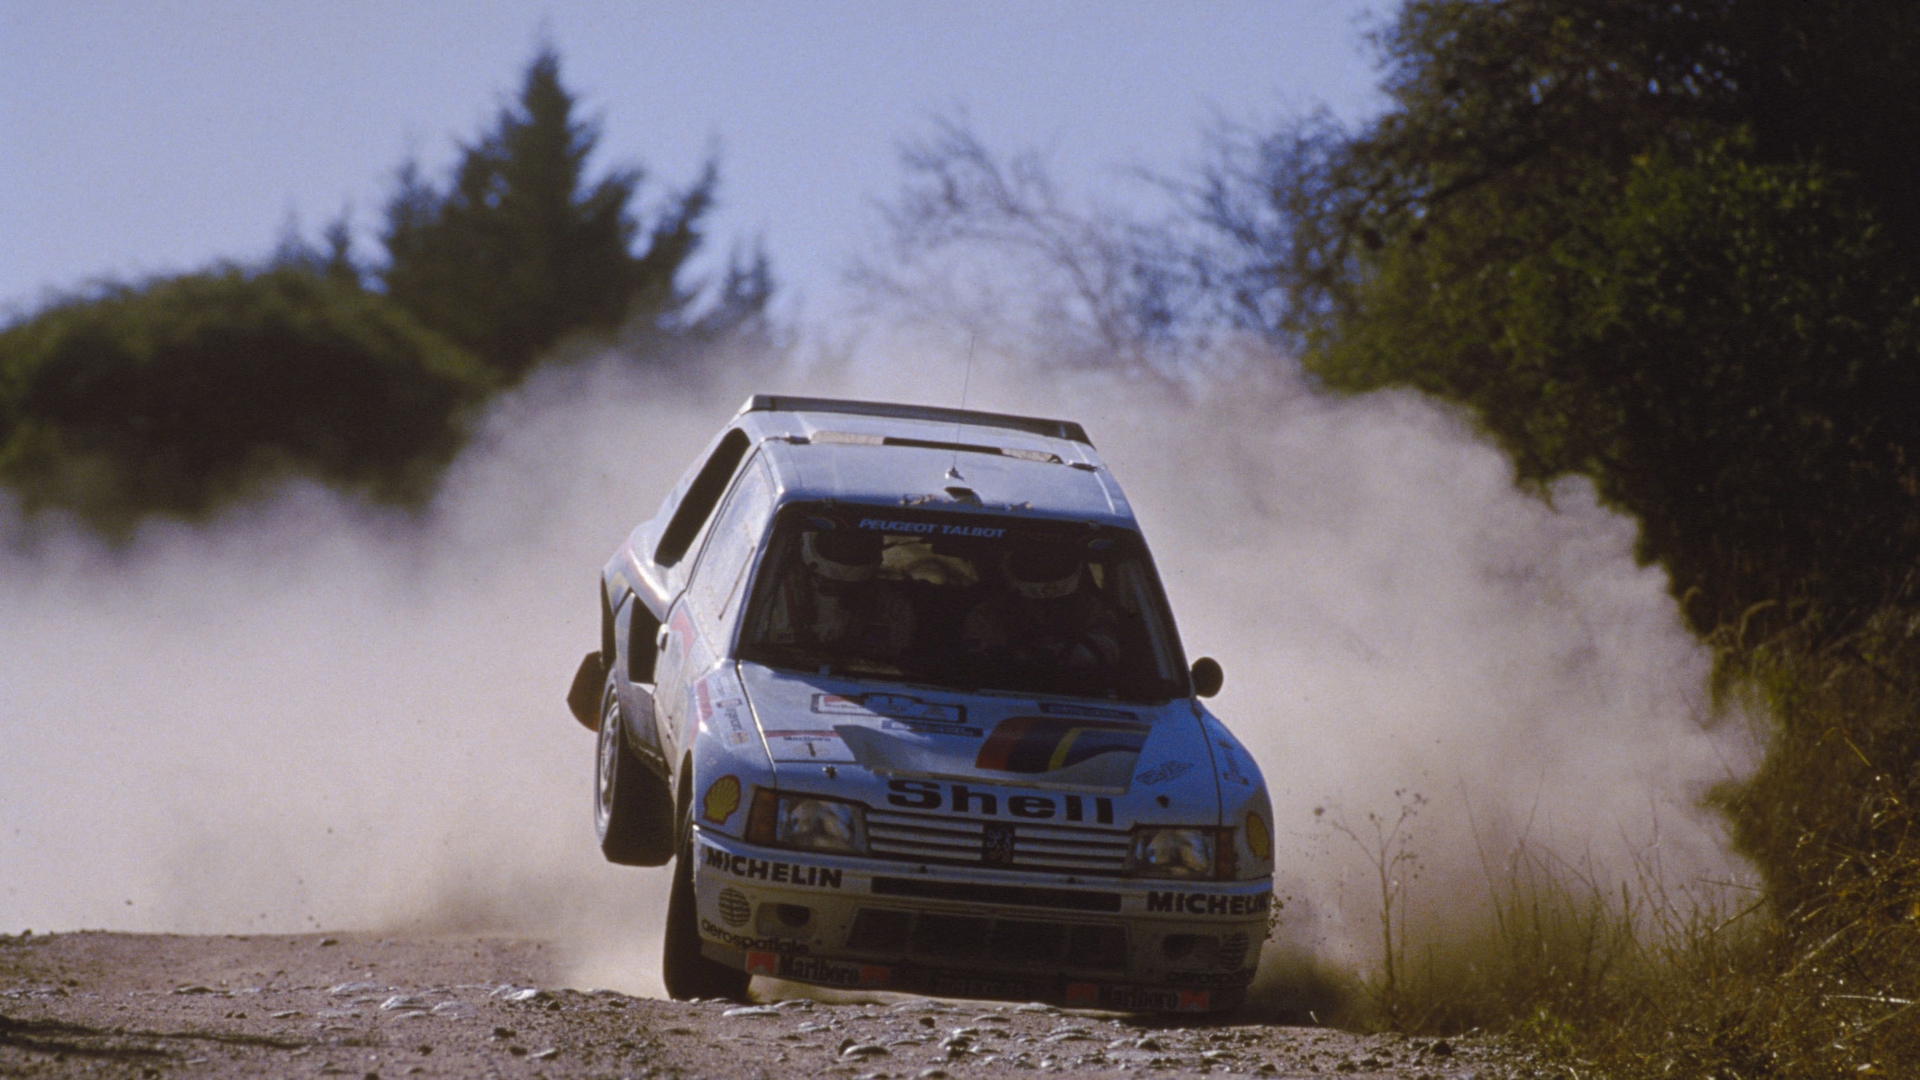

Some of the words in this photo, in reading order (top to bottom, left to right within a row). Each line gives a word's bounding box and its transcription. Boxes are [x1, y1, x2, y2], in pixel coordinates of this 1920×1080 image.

[858, 518, 937, 534] PEUGEOT
[940, 524, 1007, 539] TALBOT
[805, 742, 816, 757] 1
[887, 779, 1114, 825] Shell
[706, 847, 842, 888] MICHELIN
[701, 918, 809, 955] aerospatiale
[780, 953, 860, 984] Marlboro
